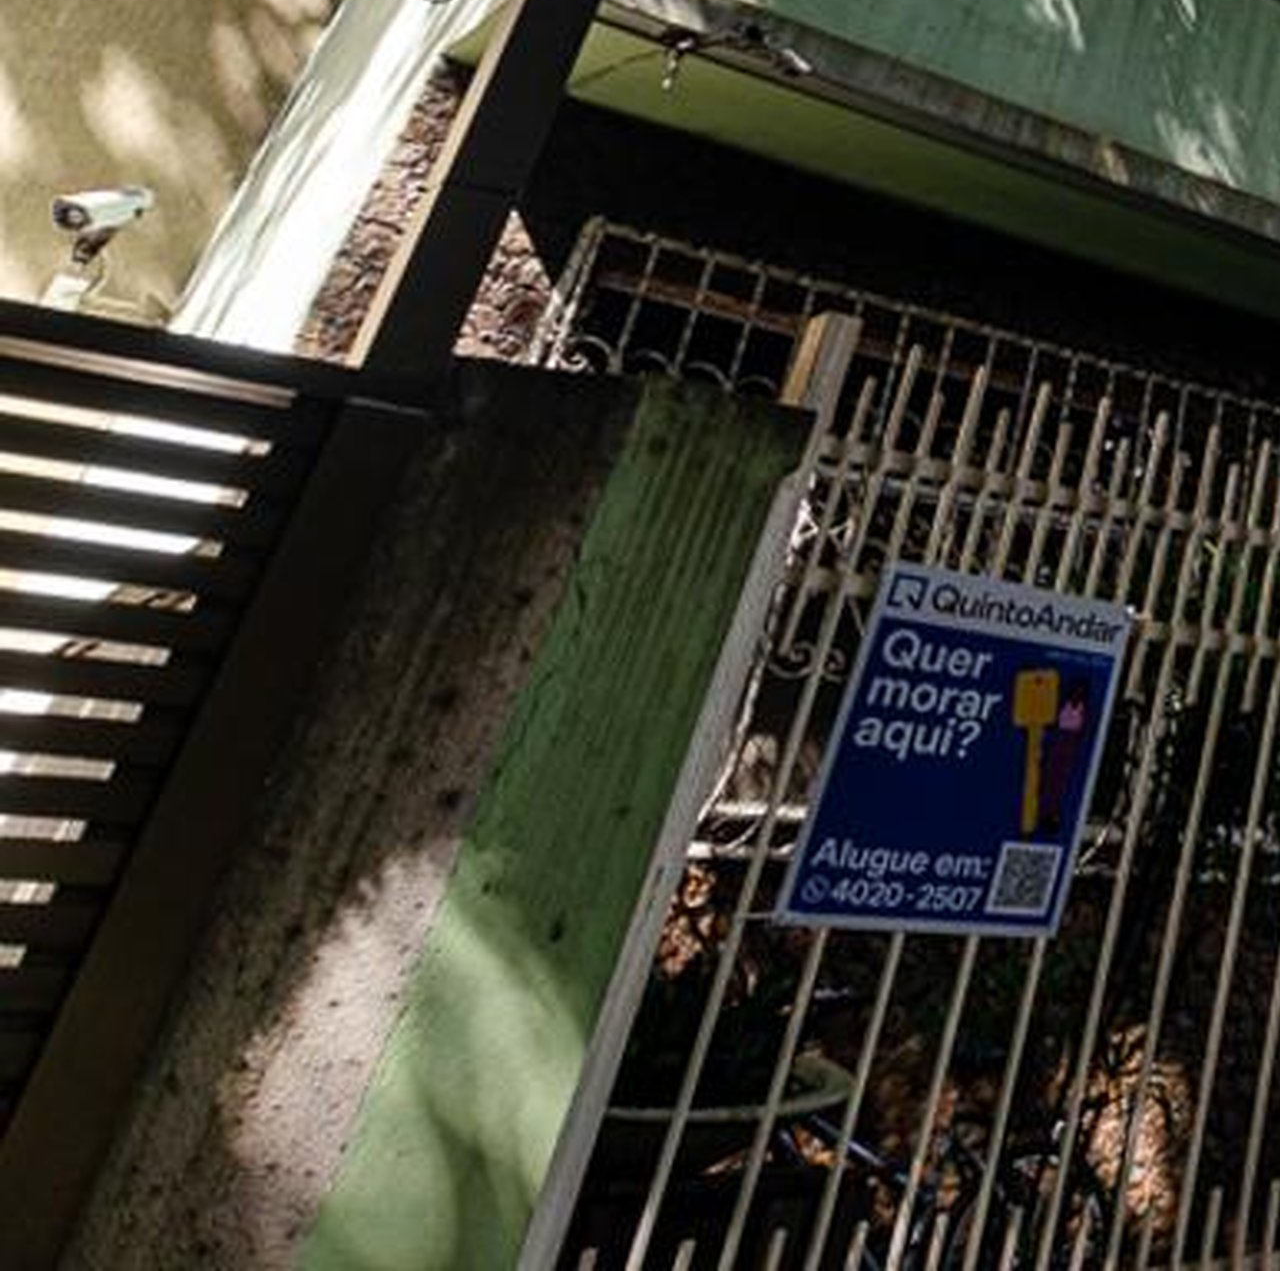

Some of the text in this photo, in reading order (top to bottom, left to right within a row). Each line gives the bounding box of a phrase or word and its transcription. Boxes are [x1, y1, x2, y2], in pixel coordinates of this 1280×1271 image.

[932, 583, 1123, 644] QuintoAndar
[882, 629, 993, 679] Quer
[866, 676, 1002, 721] morar
[854, 715, 982, 761] aqui?
[810, 837, 993, 879] Alugue em:
[831, 879, 984, 912] 4020-2507
